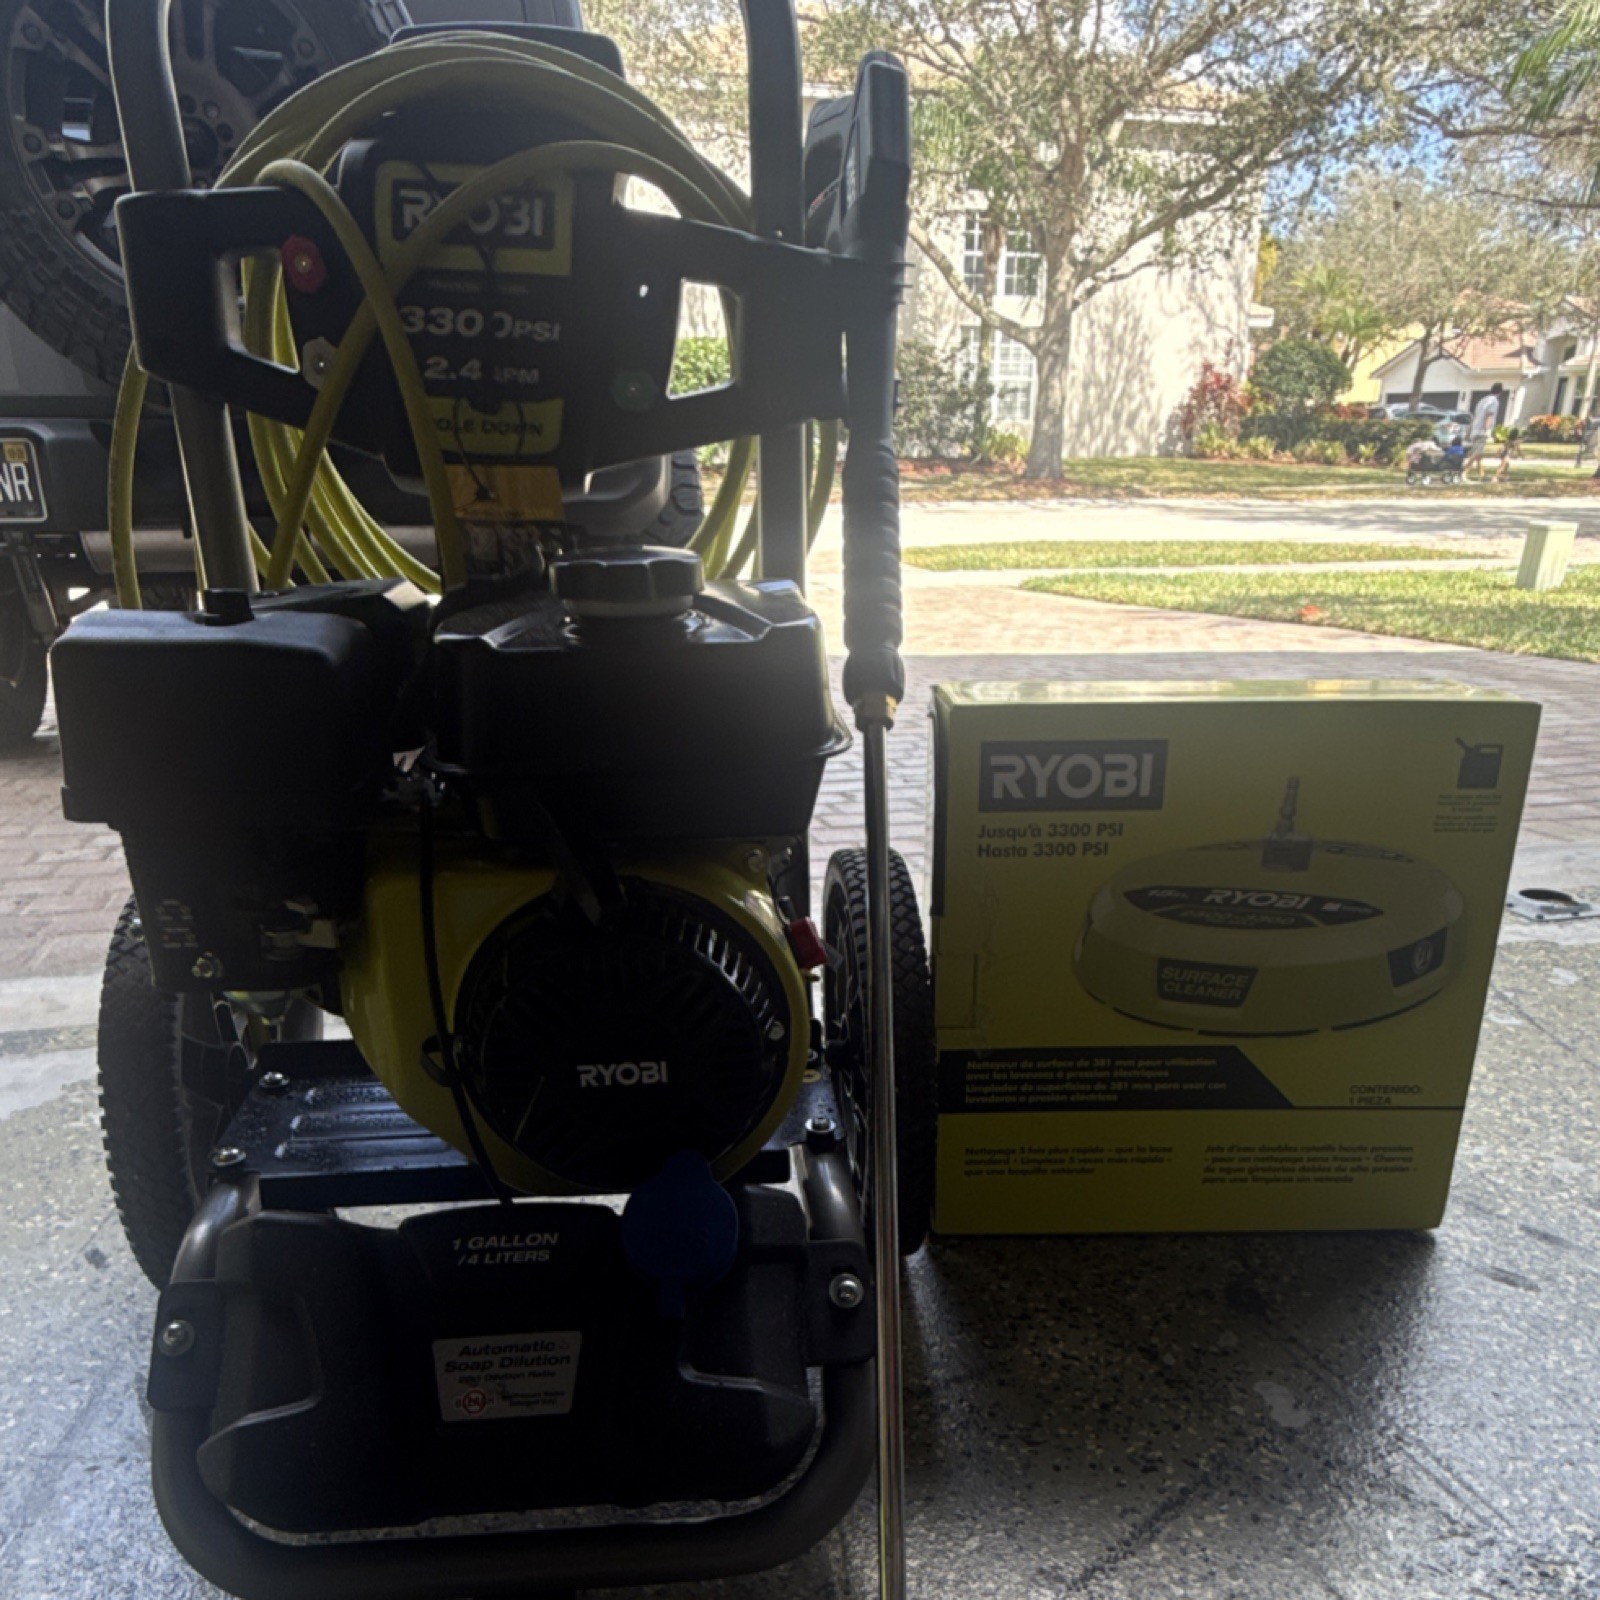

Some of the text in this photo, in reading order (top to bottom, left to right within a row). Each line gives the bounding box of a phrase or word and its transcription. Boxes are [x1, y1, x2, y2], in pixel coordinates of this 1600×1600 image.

[399, 187, 543, 237] ROBI
[423, 354, 483, 381] 2.4
[989, 752, 1154, 800] RYOBI
[977, 821, 1125, 841] Jusqu'à 3300 PSI
[977, 841, 1109, 858] Hasta 3300 PSI
[1202, 888, 1312, 910] RYOBI
[1161, 965, 1250, 989] SURFACE
[1162, 980, 1242, 1001] CLEANER
[576, 1059, 670, 1088] RYOBI
[452, 1231, 560, 1251] 1 GALLON
[483, 1249, 551, 1264] LITERS
[458, 1339, 557, 1358] Automatic
[444, 1353, 571, 1373] Soap Dilution
